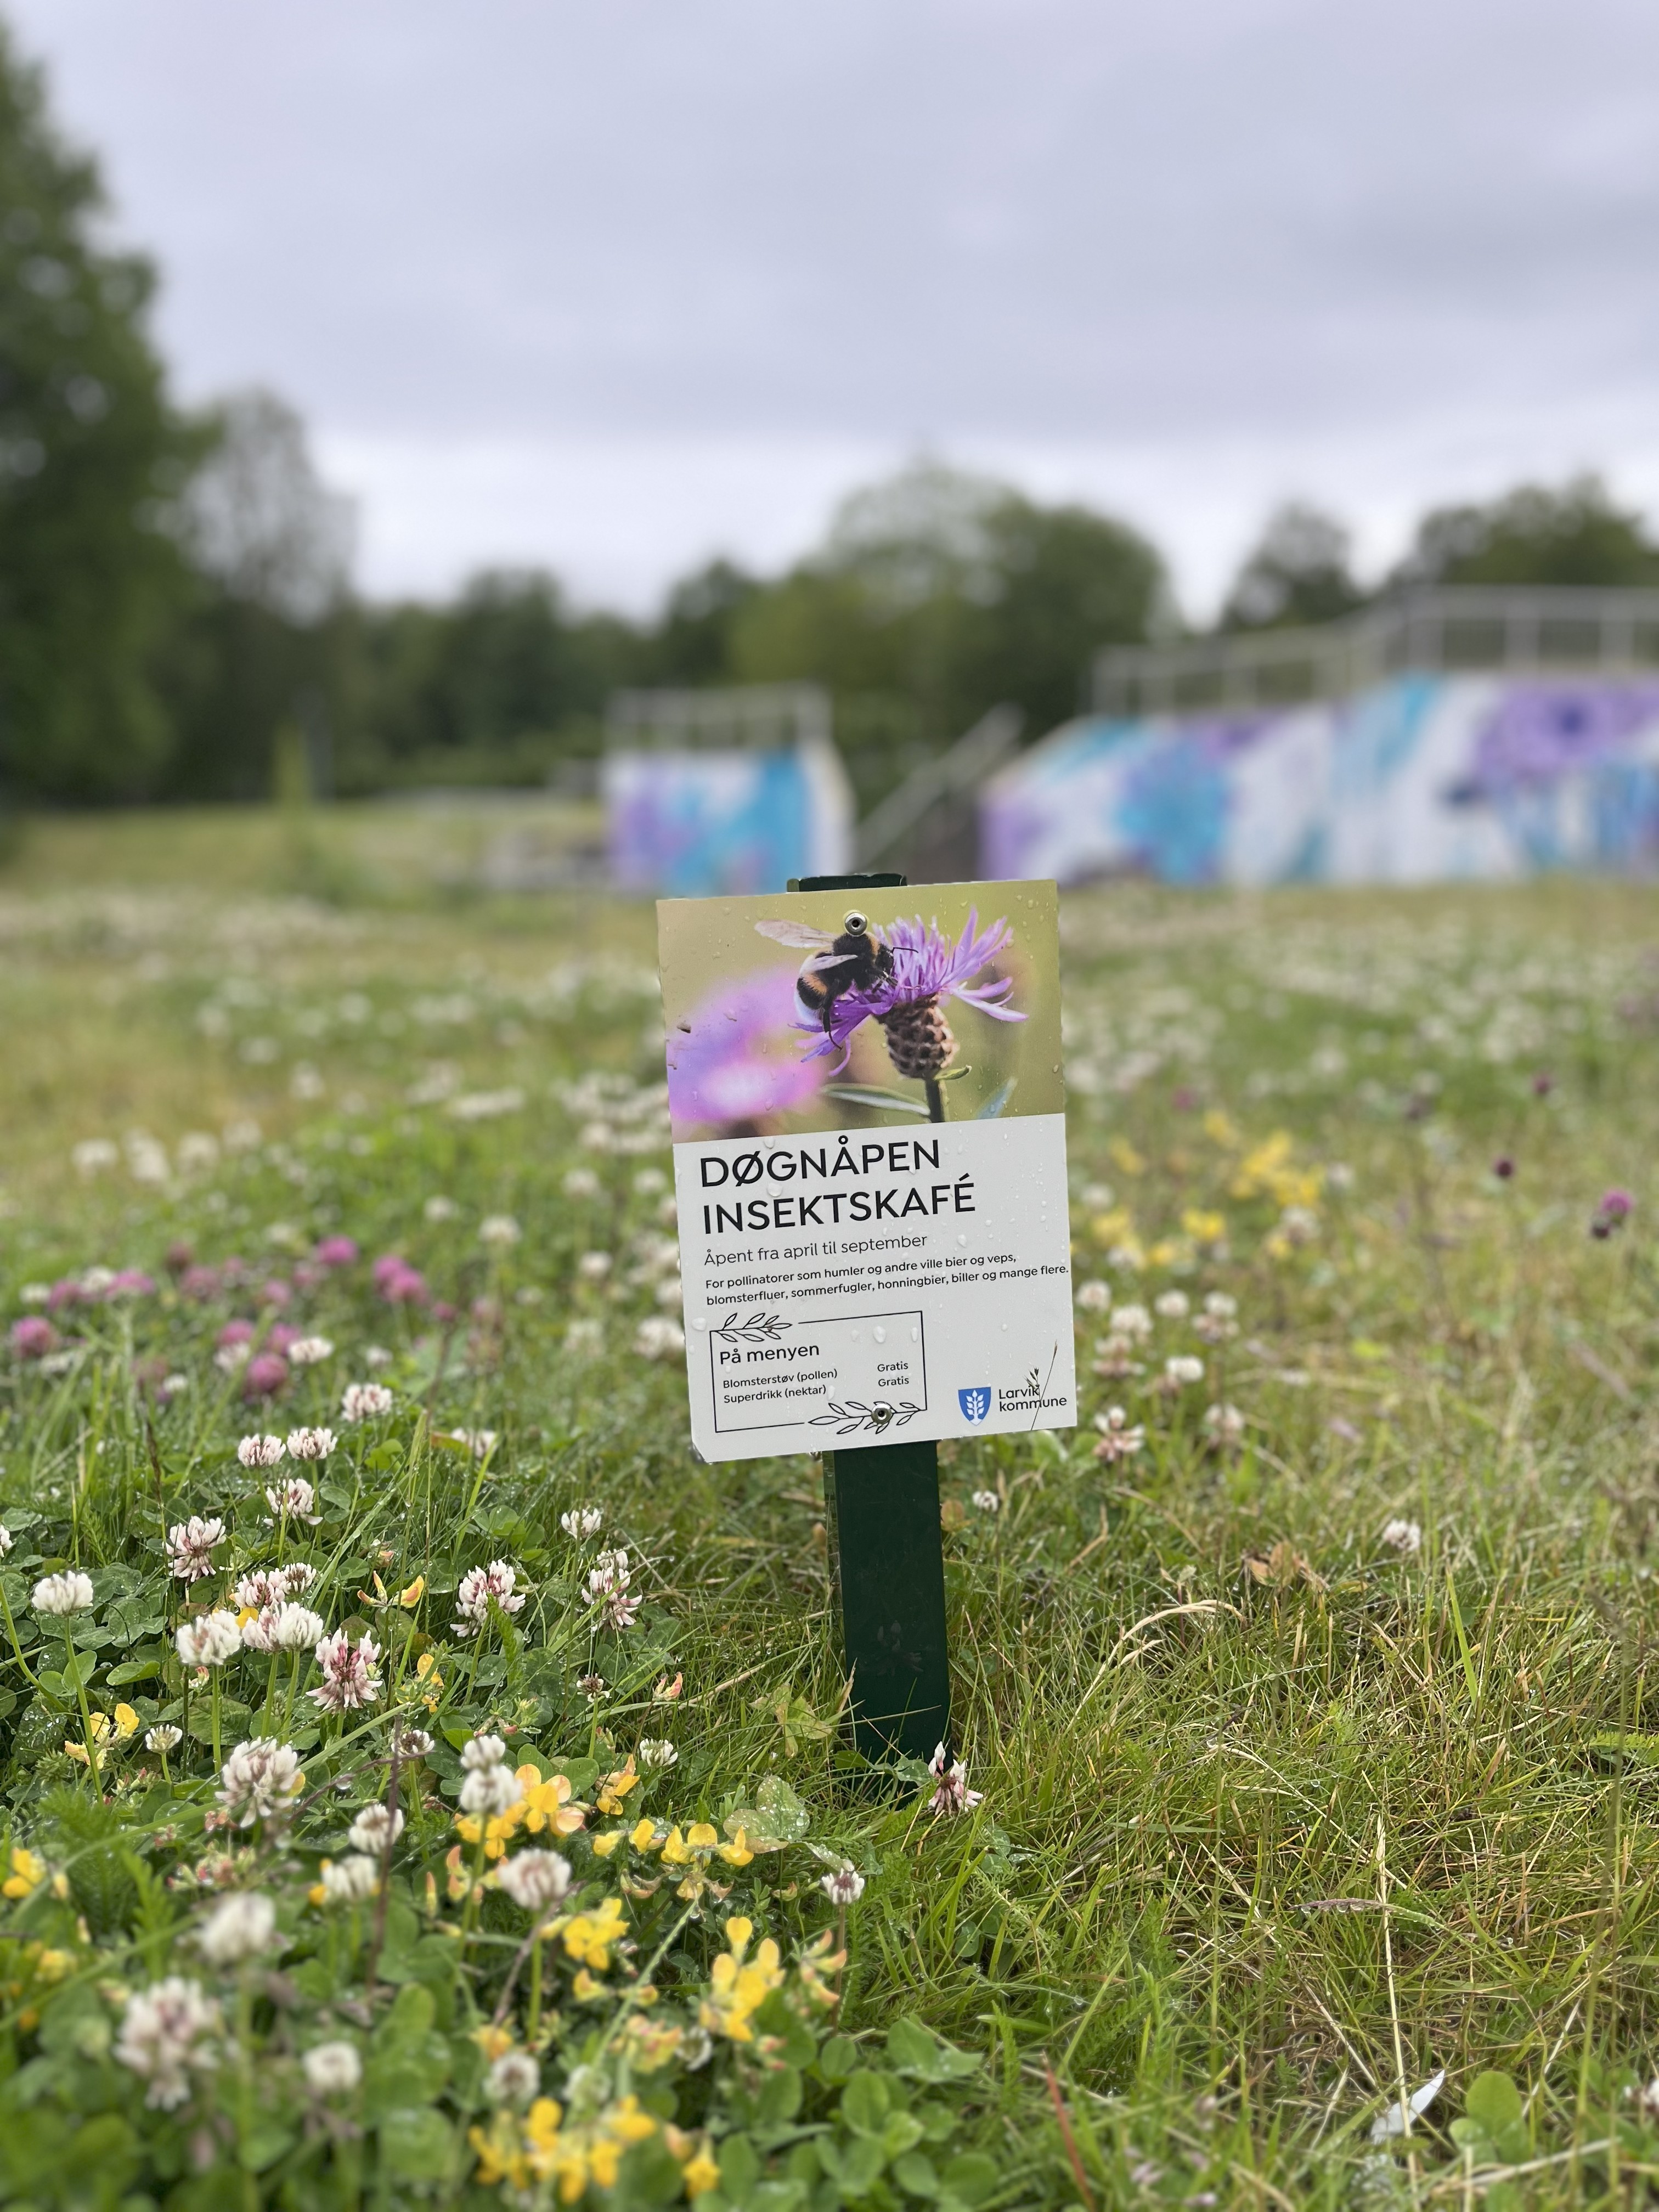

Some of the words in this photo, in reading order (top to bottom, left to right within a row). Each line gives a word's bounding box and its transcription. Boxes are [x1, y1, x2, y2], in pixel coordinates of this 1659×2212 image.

[700, 1135, 940, 1188] DØGNÅPEN
[703, 1172, 976, 1235] INSEKTSKAFÉ
[704, 1249, 754, 1267] Åpent
[757, 1247, 780, 1261] fra
[783, 1242, 819, 1260] april
[821, 1241, 837, 1255] til
[841, 1235, 928, 1255] september
[706, 1279, 725, 1289] For
[727, 1273, 795, 1289] pollinatorer
[797, 1271, 821, 1281] som
[824, 1266, 865, 1278] humler
[867, 1266, 882, 1276] og
[884, 1261, 918, 1273] andre
[919, 1259, 943, 1269] ville
[945, 1256, 968, 1267] bier
[969, 1256, 985, 1266] og
[986, 1254, 1017, 1265] veps,
[706, 1290, 788, 1306] blomsterfluer,
[791, 1282, 875, 1298] sommerfugler,
[877, 1274, 949, 1290] honningbier,
[951, 1272, 980, 1283] biller
[982, 1272, 997, 1282] og
[999, 1268, 1038, 1279] mange
[1040, 1265, 1069, 1275] flere.
[720, 1347, 742, 1365] På
[747, 1345, 820, 1363] menyen
[877, 1361, 909, 1372] Gratis
[723, 1374, 795, 1389] Blomsterstøv
[797, 1368, 838, 1383] (pollen)
[878, 1375, 910, 1387] Gratis
[724, 1389, 783, 1404] Superdrikk
[785, 1384, 826, 1398] (nektar)
[998, 1385, 1040, 1400] Larvik
[999, 1397, 1067, 1412] kommune
